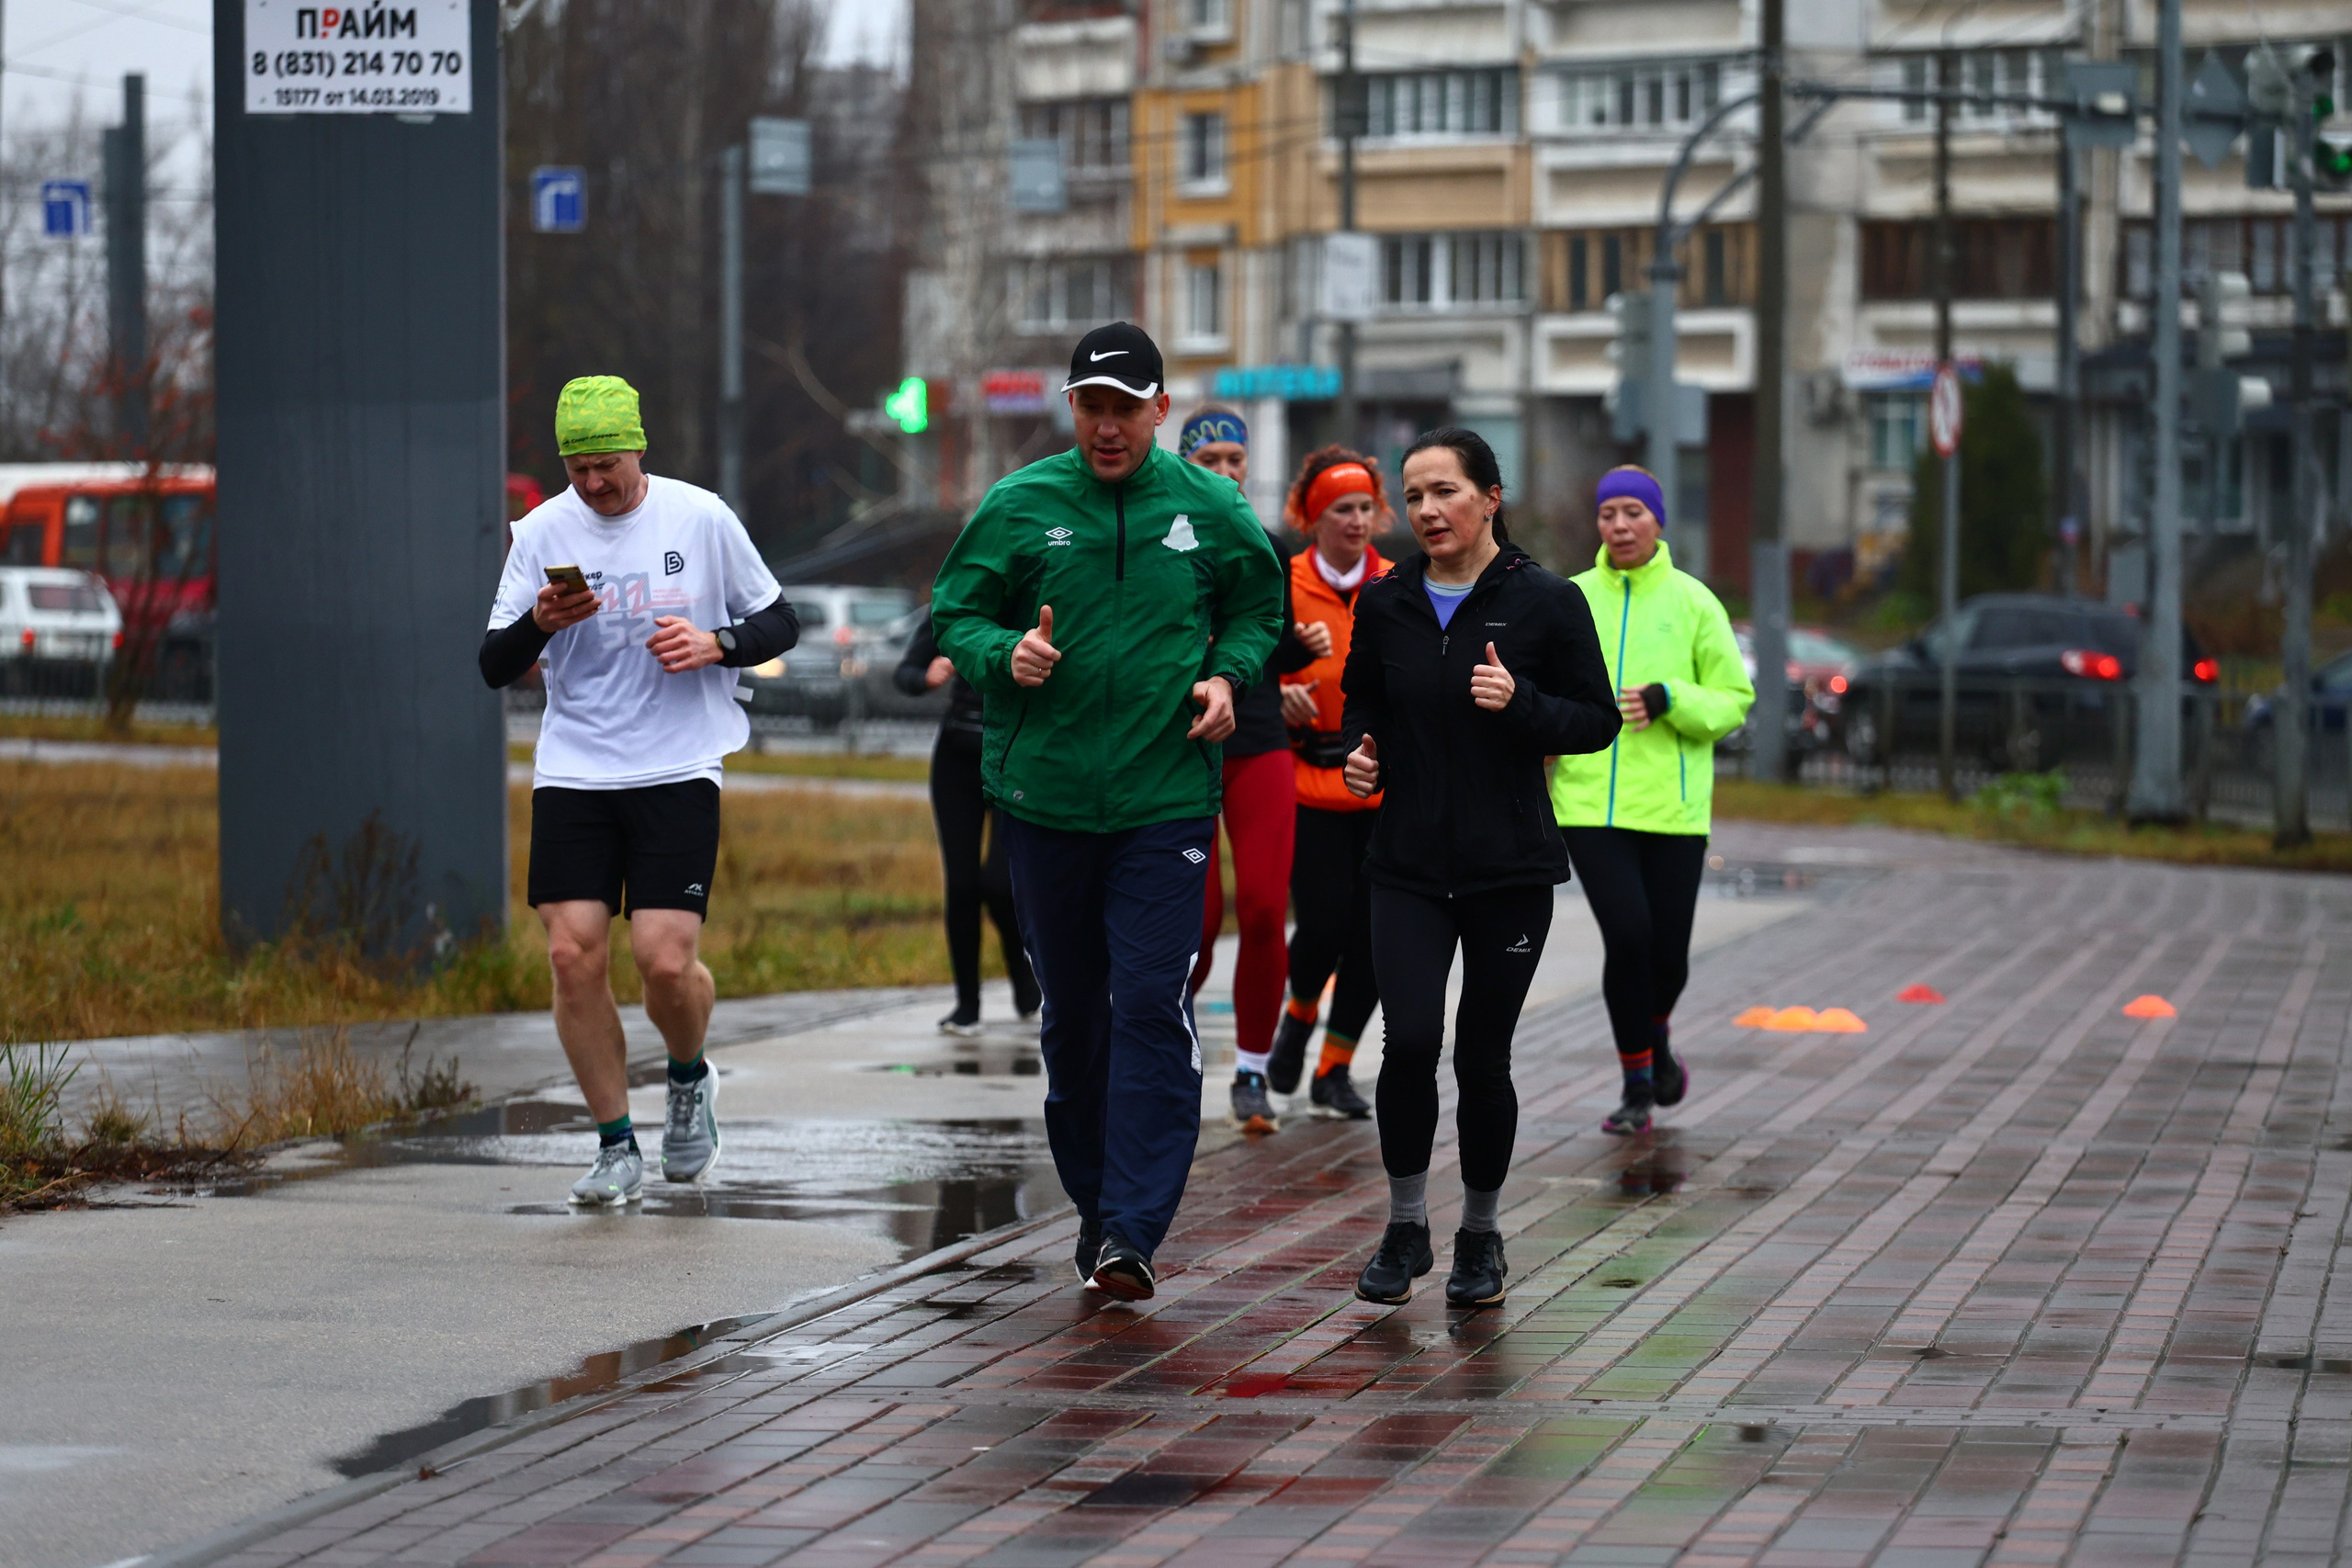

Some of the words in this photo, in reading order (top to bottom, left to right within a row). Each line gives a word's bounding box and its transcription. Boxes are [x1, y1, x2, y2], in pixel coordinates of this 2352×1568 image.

[297, 1, 417, 39] ПРАЙМ
[252, 51, 267, 75] 8
[274, 51, 336, 79] (831)
[342, 51, 384, 75] 214
[390, 51, 423, 75] 70
[430, 51, 461, 75] 70
